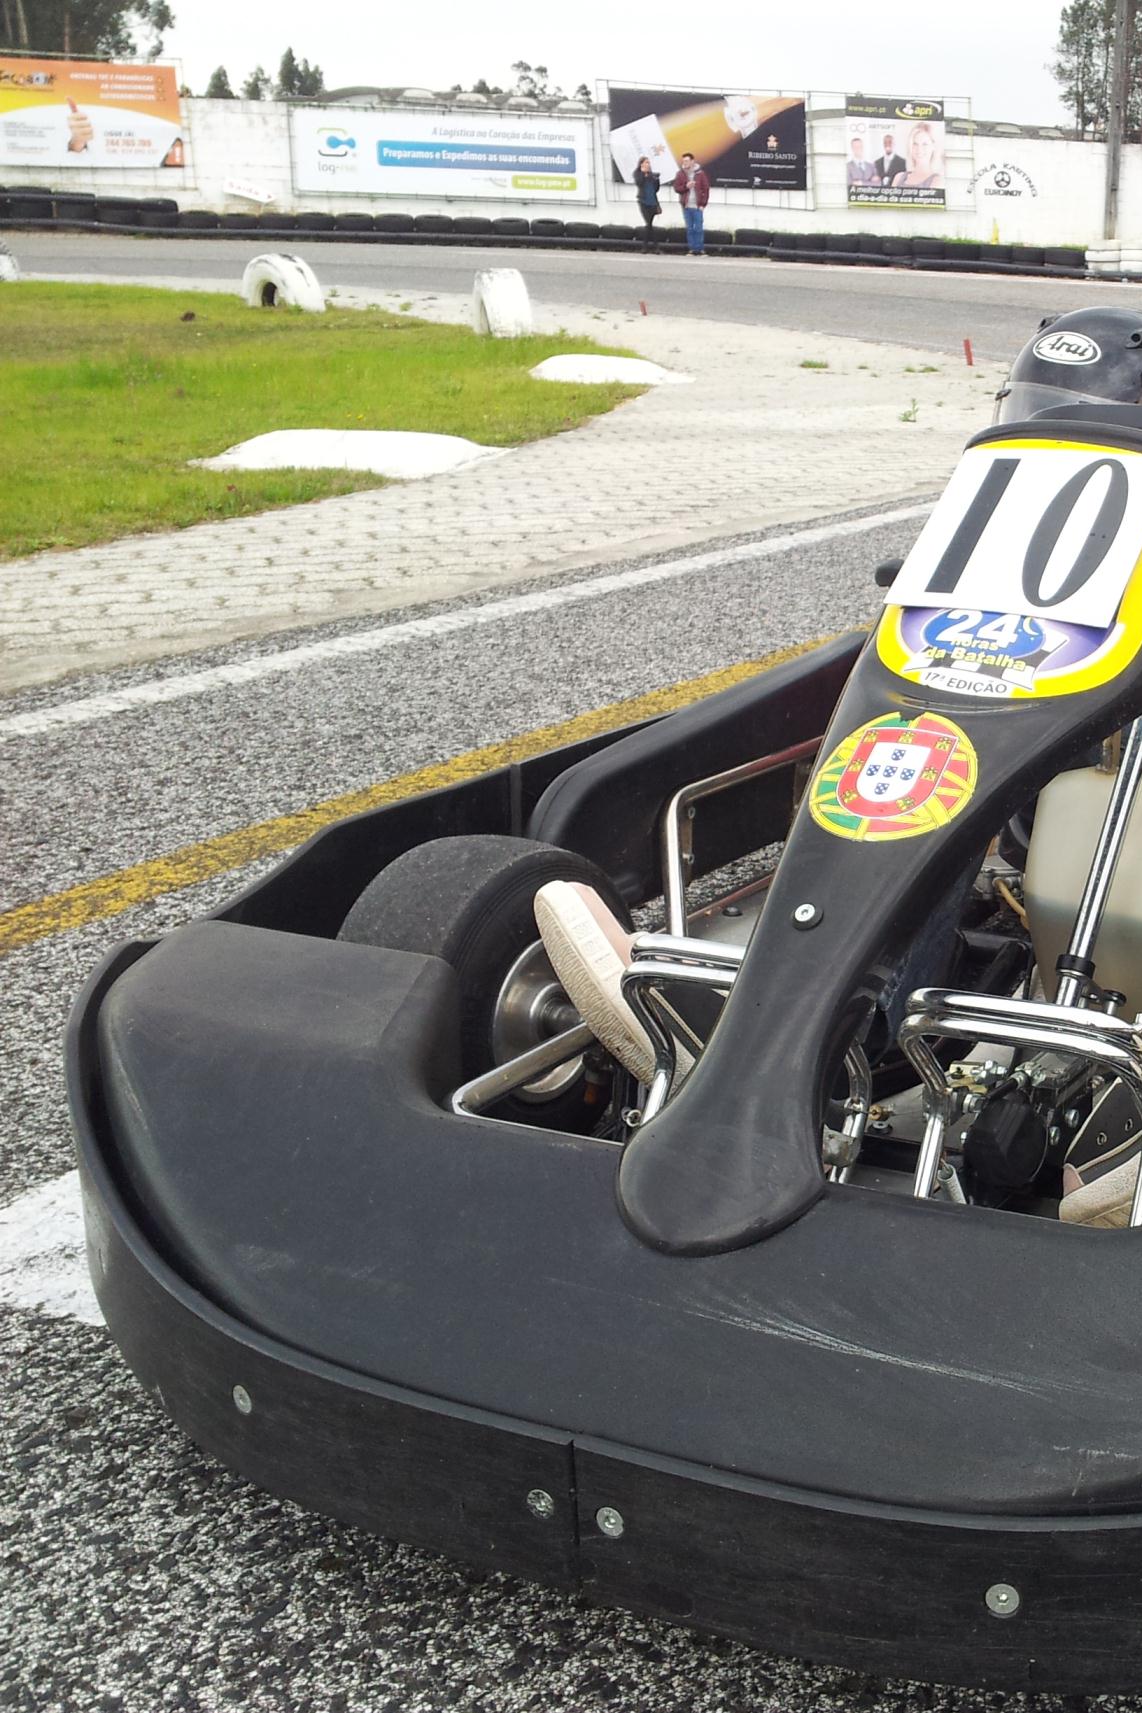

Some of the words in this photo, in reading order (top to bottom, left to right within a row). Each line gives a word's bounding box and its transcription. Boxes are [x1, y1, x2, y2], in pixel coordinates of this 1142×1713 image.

[914, 105, 933, 115] apri
[488, 129, 520, 141] Coração
[521, 131, 536, 140] das
[537, 132, 576, 143] Empresas
[383, 147, 434, 160] Preparamos
[435, 151, 441, 159] e
[442, 150, 487, 162] Expedimos
[488, 154, 498, 162] as
[498, 154, 518, 163] suas
[518, 154, 570, 165] encomendas
[775, 152, 798, 160] SANTO
[1043, 335, 1093, 357] Arai
[924, 457, 1129, 608] 10
[935, 609, 1022, 649] 24
[926, 646, 947, 661] da
[951, 647, 1027, 672] Batalha
[946, 676, 1009, 695] EDIÇÃO
